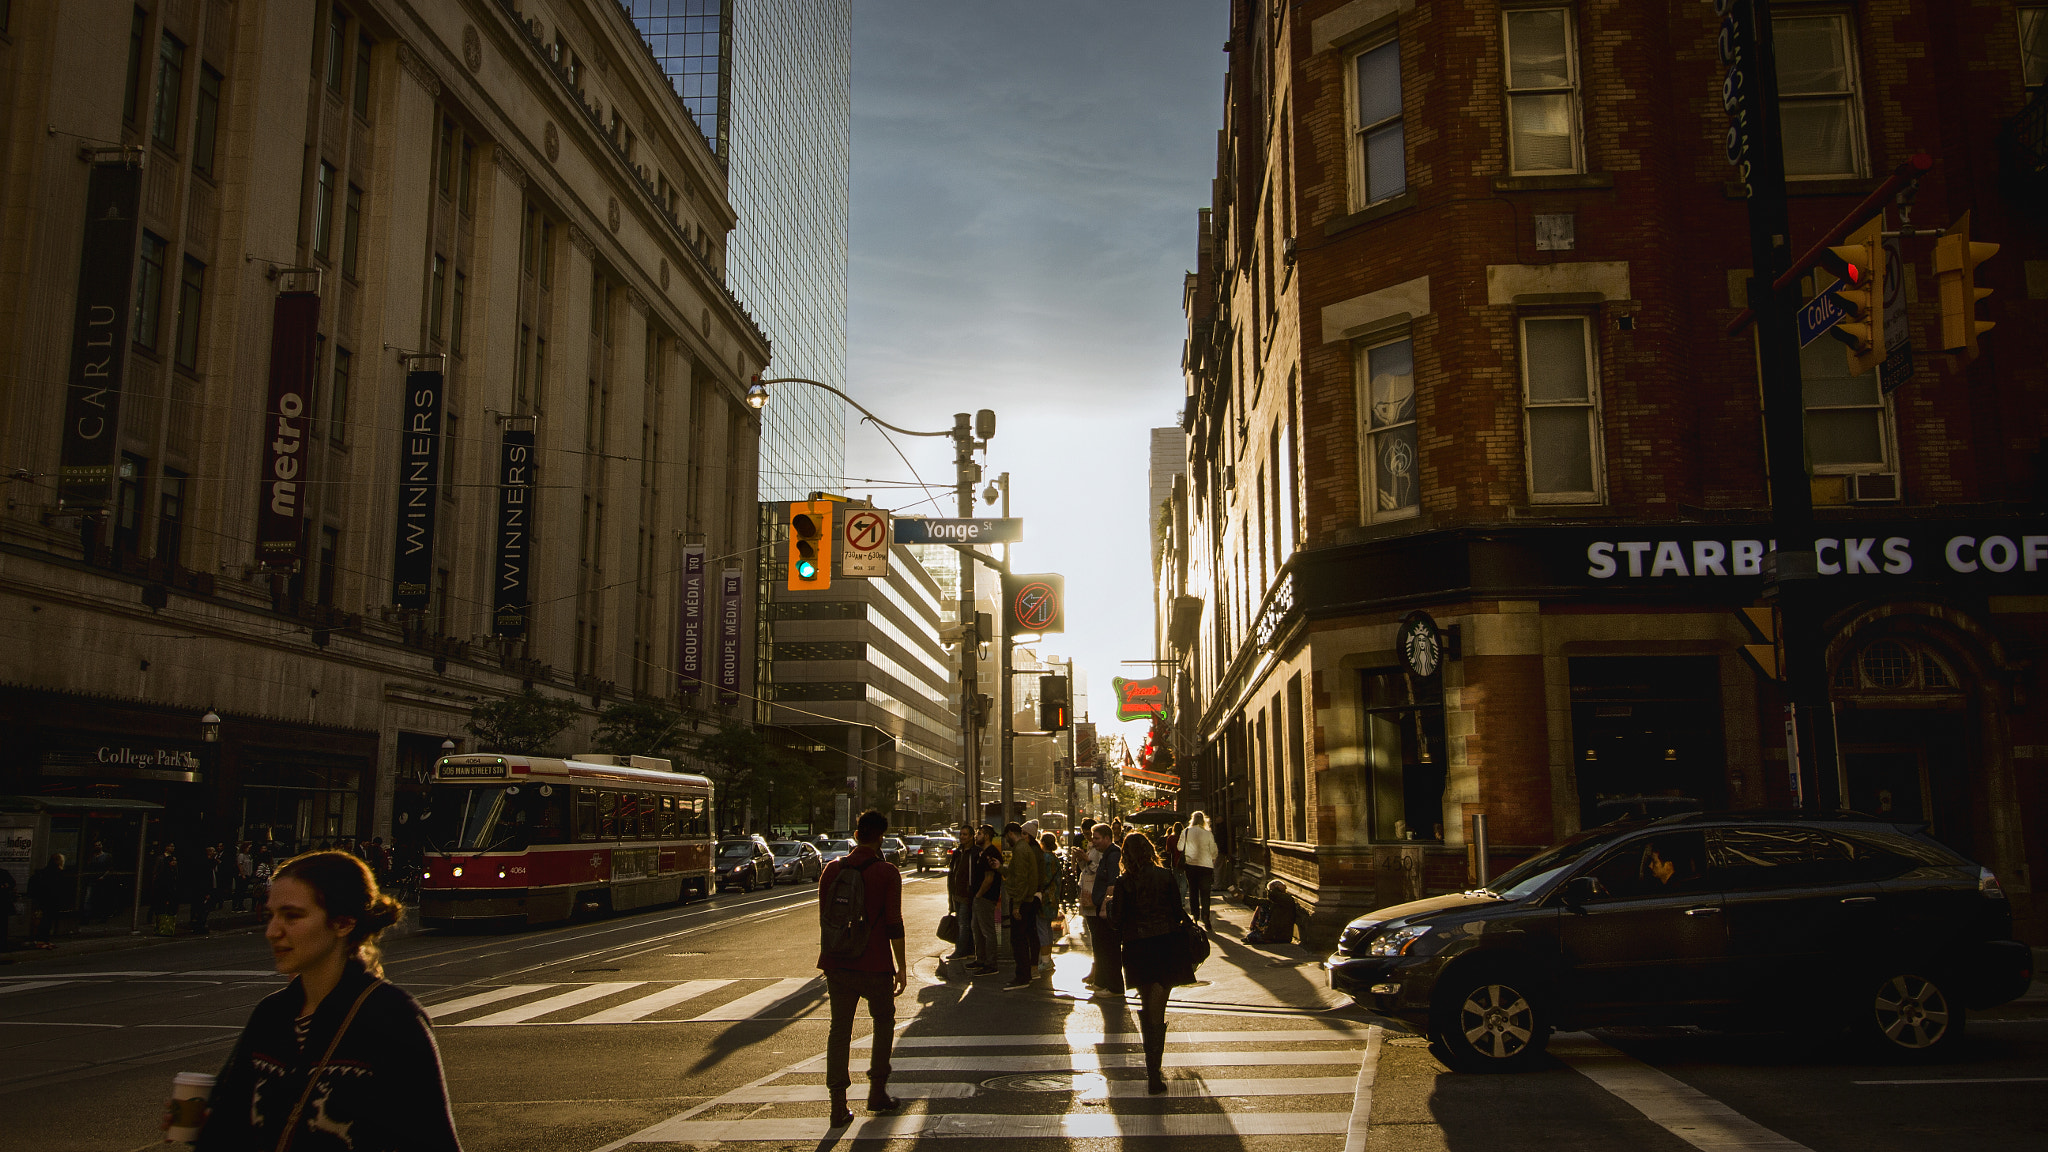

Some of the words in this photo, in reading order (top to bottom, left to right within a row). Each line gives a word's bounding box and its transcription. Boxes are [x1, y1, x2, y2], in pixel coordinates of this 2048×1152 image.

[78, 304, 116, 440] CARLU
[271, 392, 303, 517] metro
[405, 388, 434, 556] WINNERS
[502, 445, 527, 591] WINNERS
[924, 521, 979, 543] Yonge
[983, 521, 993, 530] St
[1587, 537, 1913, 579] STARBCKS
[1945, 534, 2048, 574] COF
[684, 578, 700, 617] MÉDIA
[723, 599, 738, 636] MÉDIA
[684, 622, 699, 672] GROUPE
[723, 640, 737, 685] GROUPE
[97, 746, 154, 769] College
[157, 748, 181, 767] Park
[442, 767, 455, 776] 506
[455, 766, 471, 776] MAIN
[471, 766, 492, 775] STREET
[492, 766, 505, 774] STN
[7, 836, 32, 850] Indigo
[1382, 855, 1413, 872] 450
